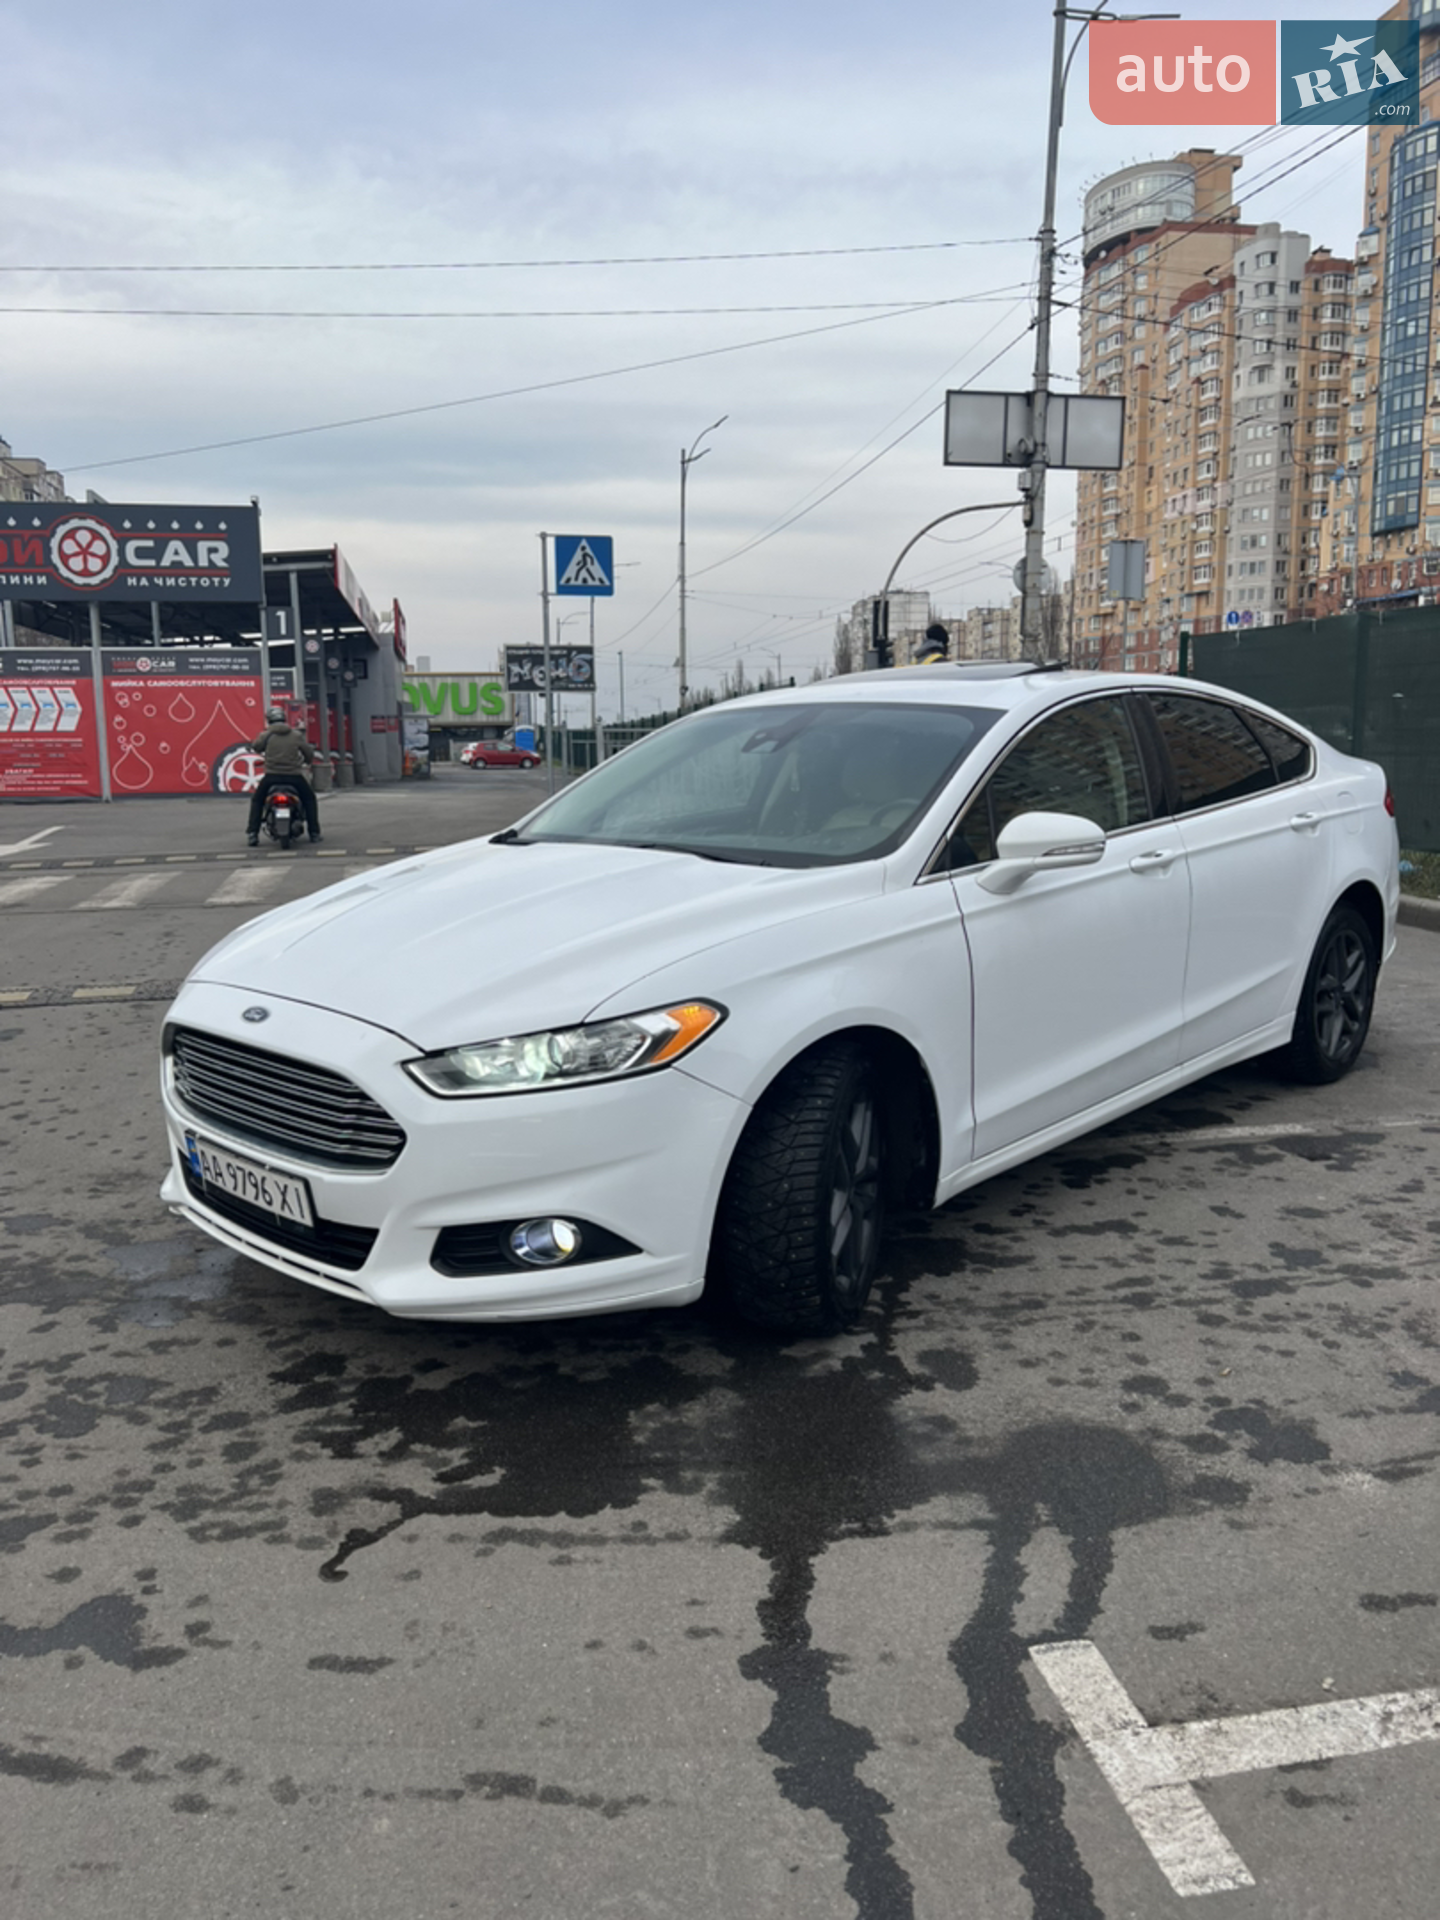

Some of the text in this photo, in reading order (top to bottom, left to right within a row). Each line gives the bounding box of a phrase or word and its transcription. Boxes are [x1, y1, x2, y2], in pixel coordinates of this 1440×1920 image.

[125, 539, 230, 567] CAR
[127, 576, 231, 588] НА ЧИСТОТУ
[275, 611, 287, 635] 1
[200, 1150, 305, 1219] AA 9796 XI
